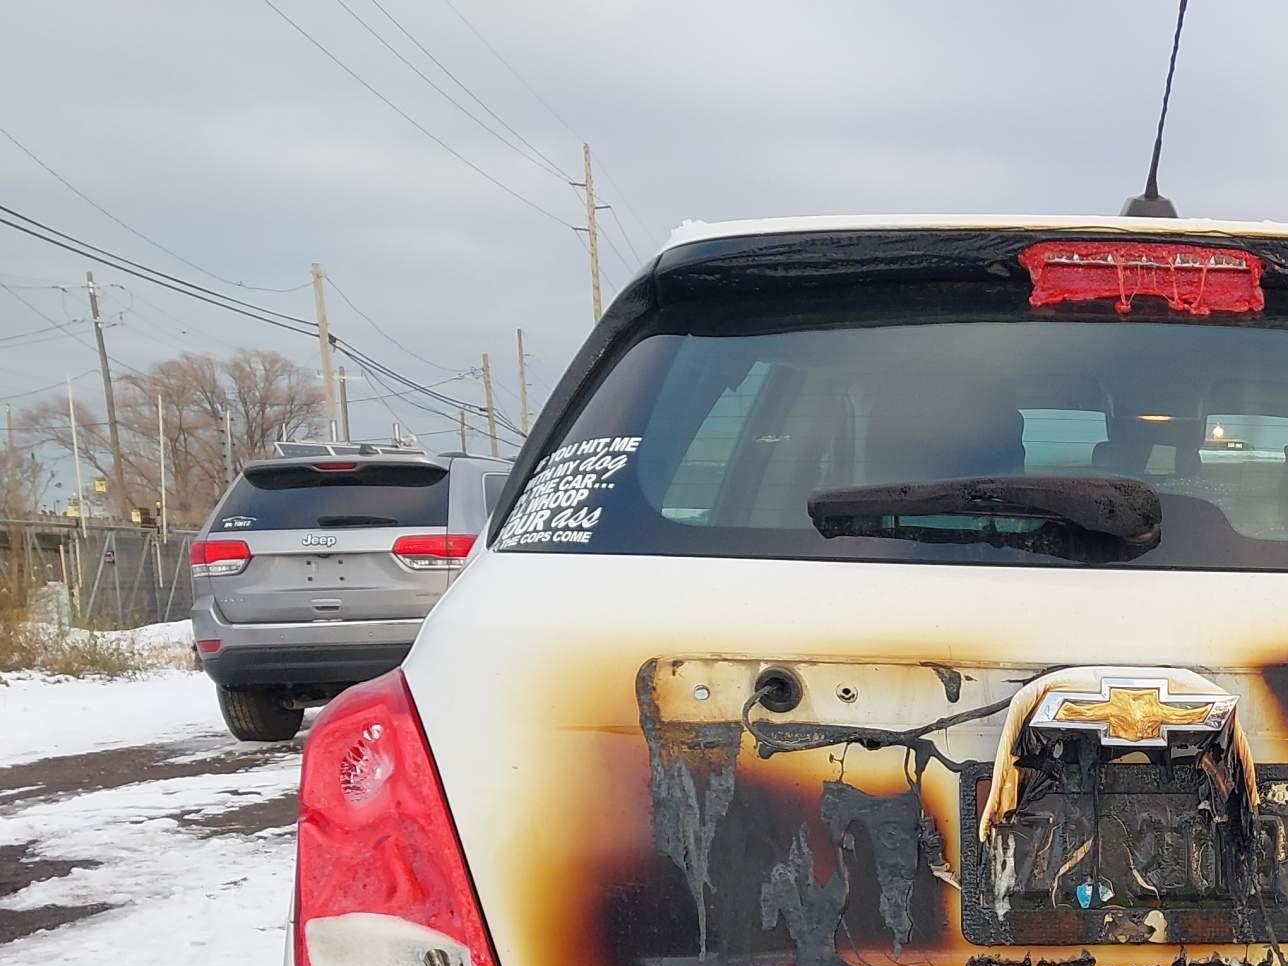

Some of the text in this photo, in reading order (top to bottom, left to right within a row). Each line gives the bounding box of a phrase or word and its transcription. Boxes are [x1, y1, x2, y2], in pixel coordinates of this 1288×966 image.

[548, 443, 579, 464] YOU
[577, 438, 611, 455] HIT
[609, 437, 642, 452] ME
[553, 460, 580, 478] MY
[579, 447, 629, 480] dog
[526, 489, 590, 514] WHOOP
[530, 479, 559, 499] THE
[492, 507, 604, 544] YOUR ass
[302, 534, 336, 547] Jeep
[500, 535, 521, 549] THE
[520, 532, 553, 545] COPS
[552, 531, 592, 543] COME
